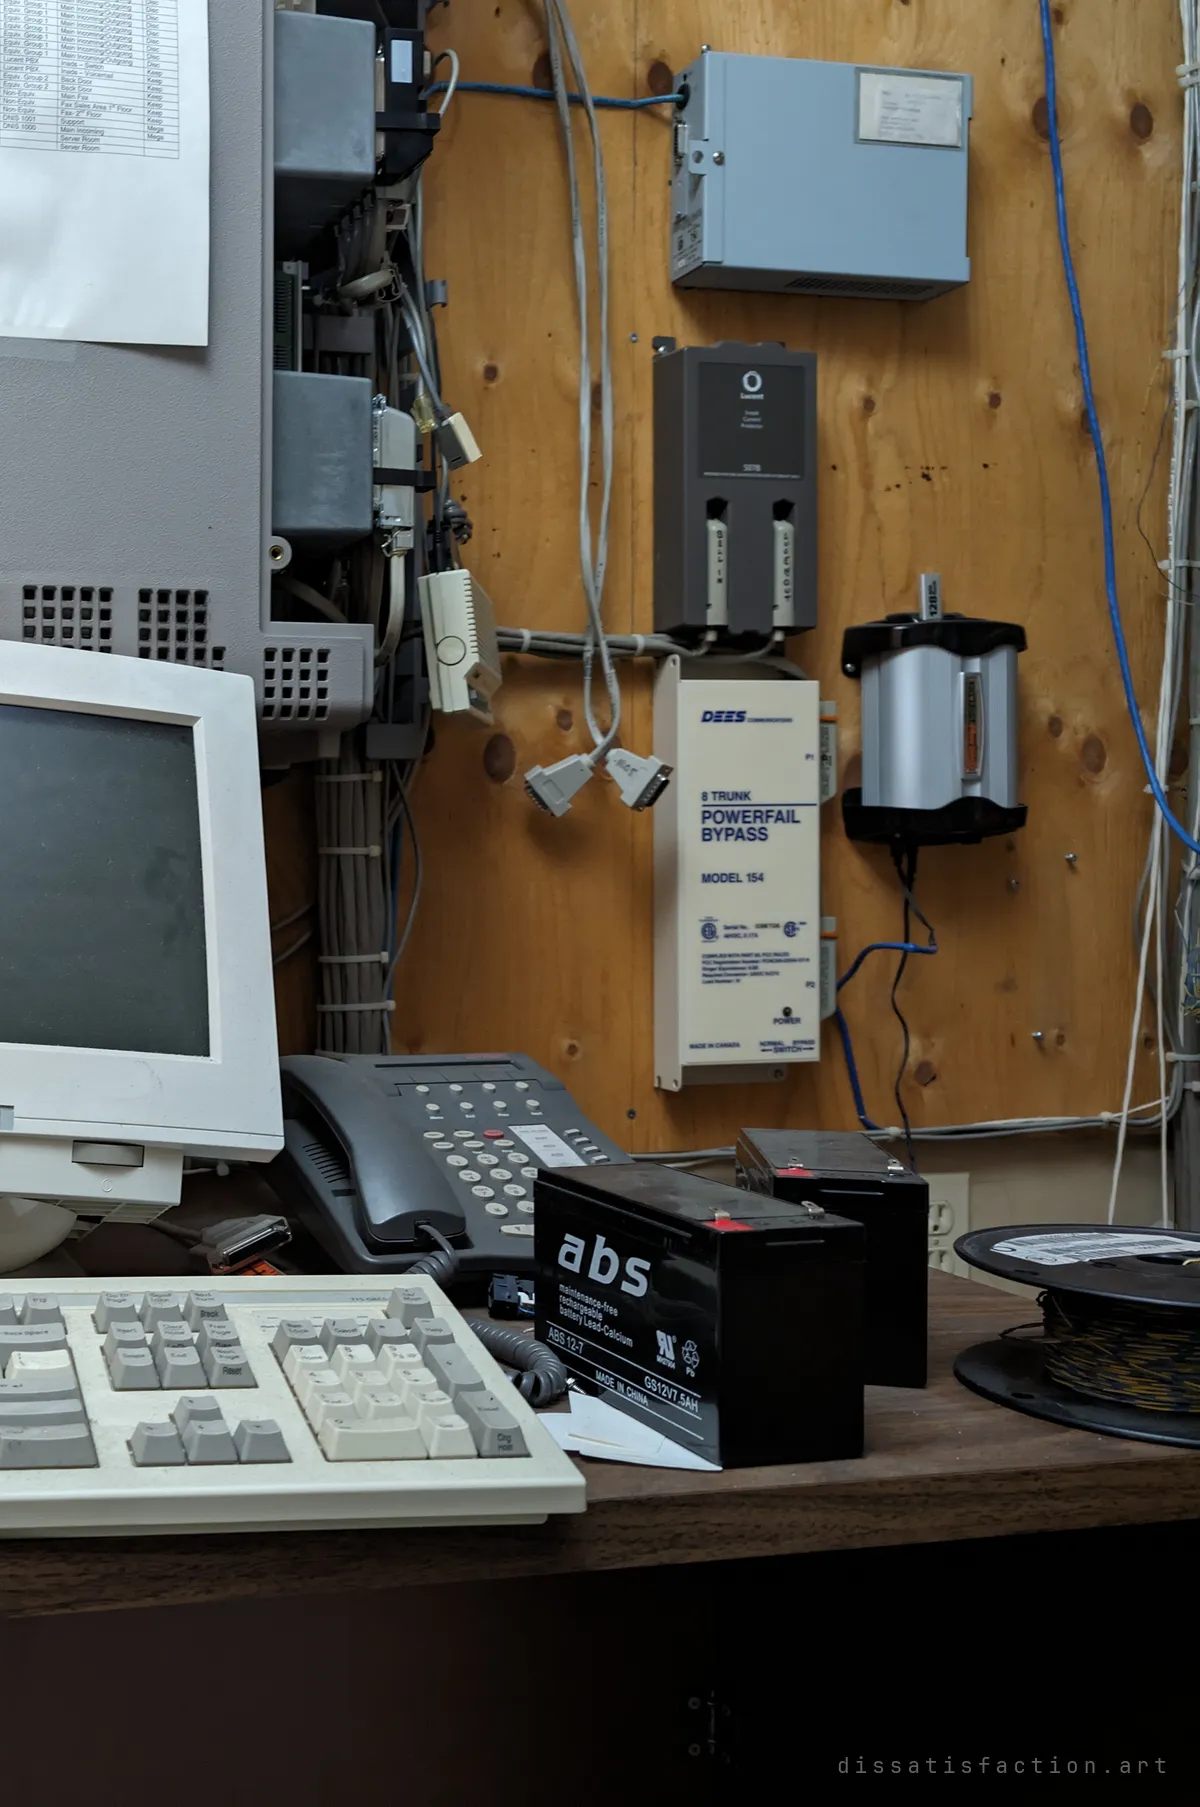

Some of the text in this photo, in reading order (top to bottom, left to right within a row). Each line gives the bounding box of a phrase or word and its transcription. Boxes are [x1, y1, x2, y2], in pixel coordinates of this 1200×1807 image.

[60, 117, 85, 125] Support
[77, 128, 104, 136] Incoming
[701, 710, 747, 723] DEES
[702, 791, 751, 801] 8 TRUNK
[701, 809, 801, 824] POWERFAIL
[701, 826, 768, 842] BYPASS
[701, 873, 764, 884] MODEL 154
[773, 1017, 801, 1025] POWER
[557, 1232, 652, 1298] abs
[559, 1283, 618, 1317] maintenance-free
[559, 1295, 602, 1322] rechargeable
[559, 1305, 633, 1348] battery Lead-Calcium
[548, 1327, 584, 1354] ABS 12-7
[222, 1366, 242, 1375] Reset
[685, 1366, 696, 1378] Pb
[595, 1370, 649, 1407] MADE IN CHINA
[644, 1376, 699, 1412] GS12V7.5AH
